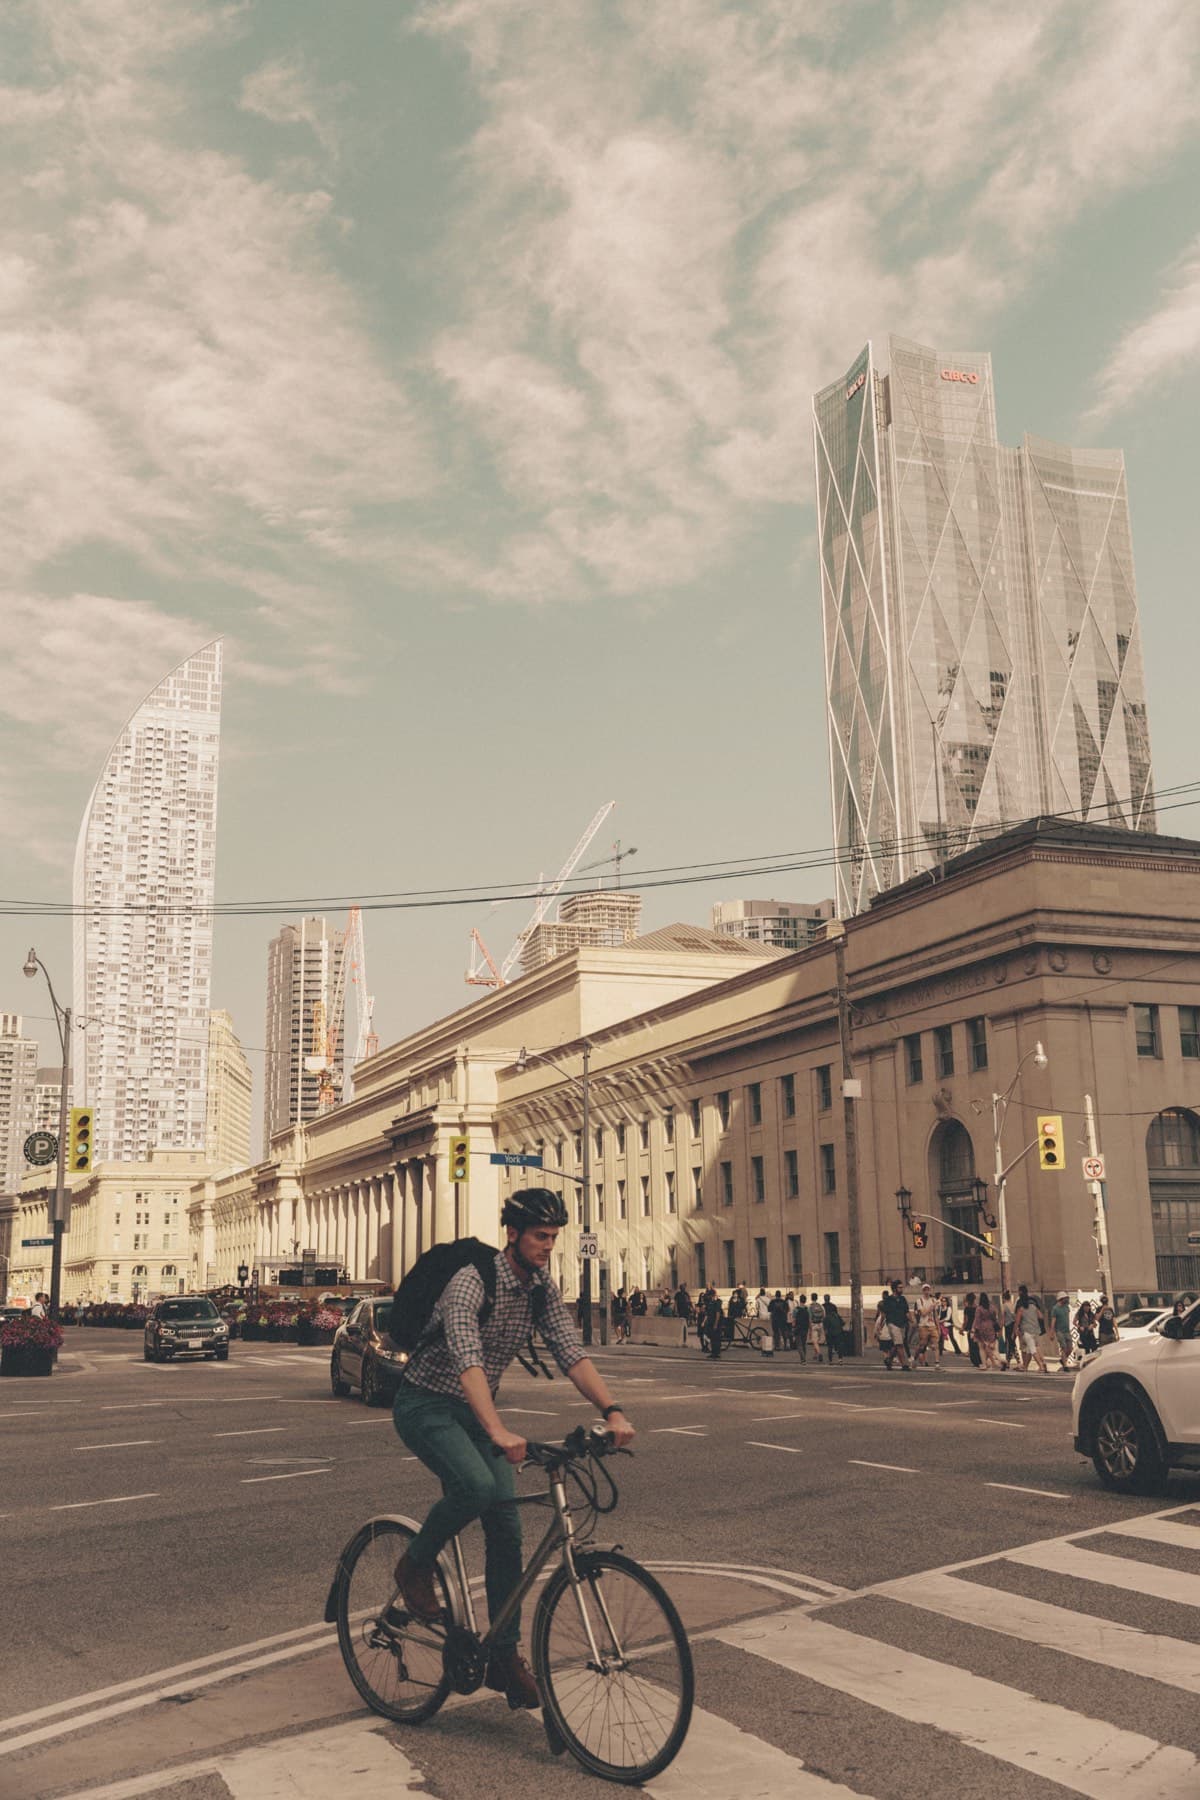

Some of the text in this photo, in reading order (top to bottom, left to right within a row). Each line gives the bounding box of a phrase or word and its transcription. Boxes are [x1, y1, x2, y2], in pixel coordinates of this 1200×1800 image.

[941, 369, 967, 383] CIBC
[36, 1140, 49, 1154] P
[505, 1154, 520, 1164] York
[581, 1244, 597, 1256] 40
